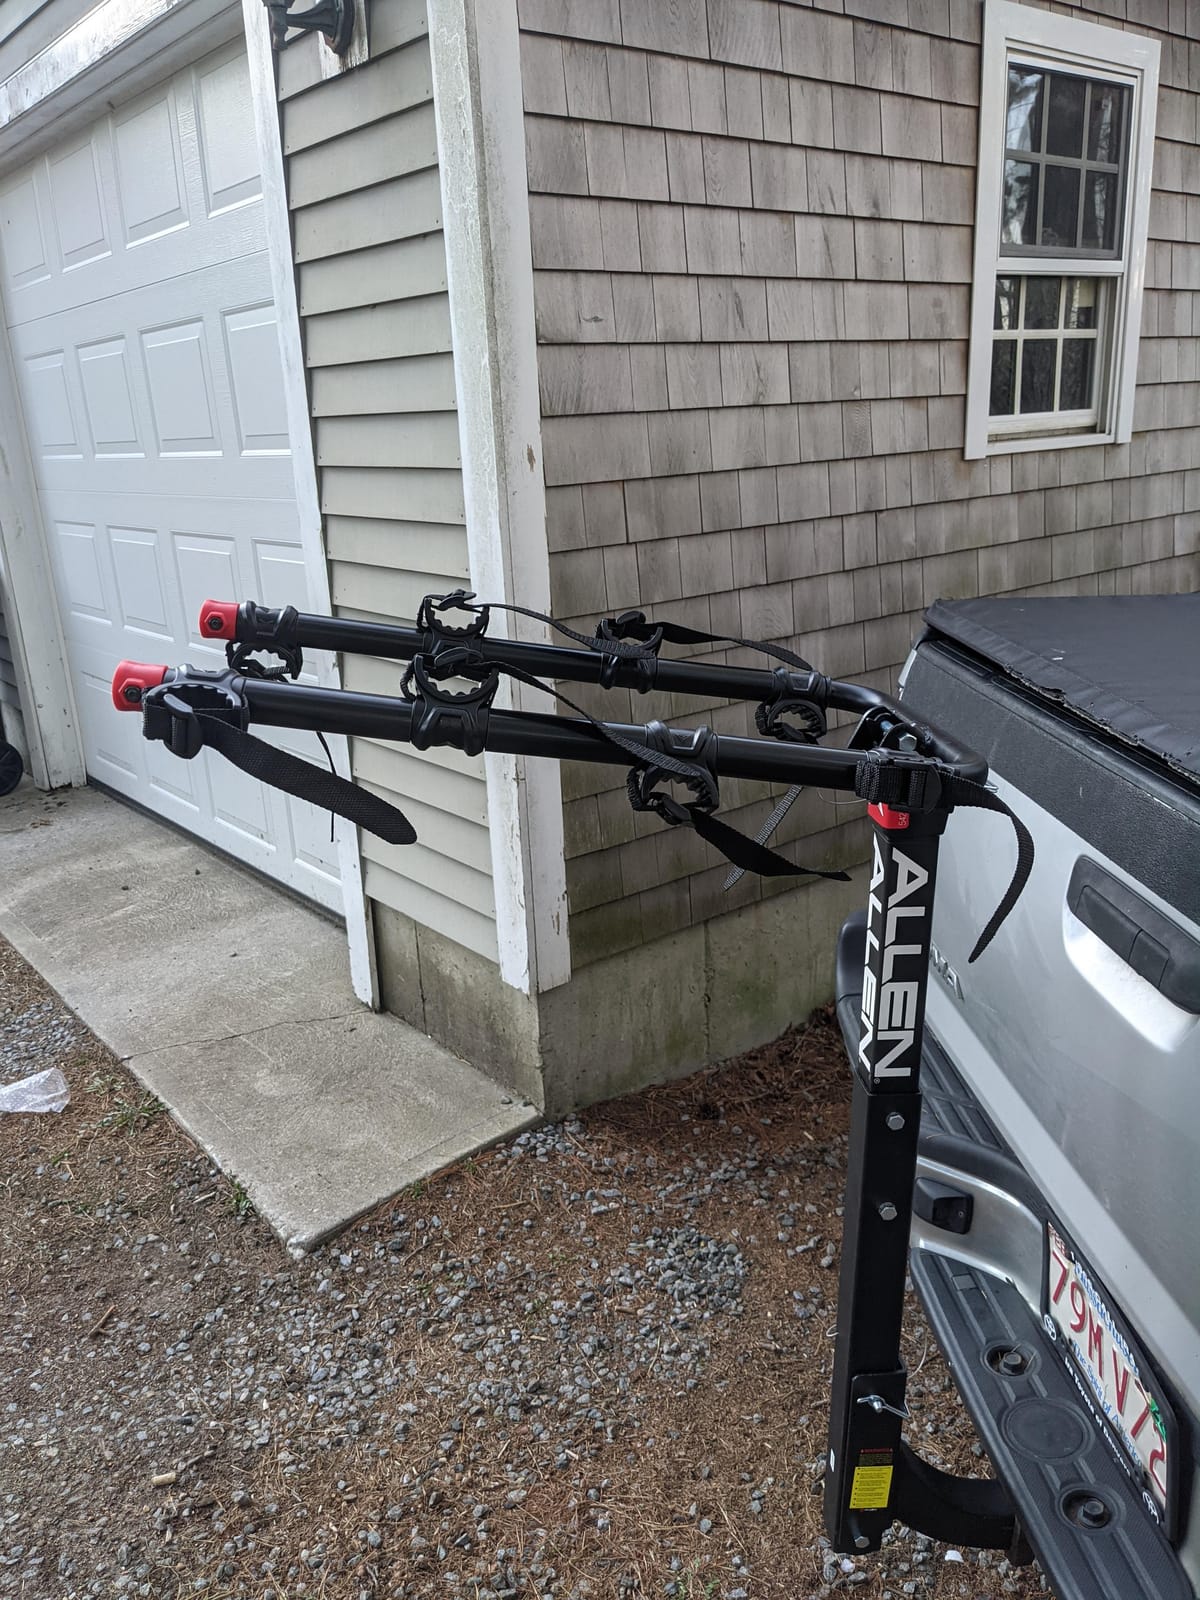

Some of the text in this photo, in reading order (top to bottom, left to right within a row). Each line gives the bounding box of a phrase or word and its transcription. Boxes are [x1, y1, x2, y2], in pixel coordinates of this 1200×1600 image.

[859, 832, 885, 1073] ALLEN
[874, 847, 929, 1078] ALLEN
[1074, 1258, 1139, 1377] Massachuse
